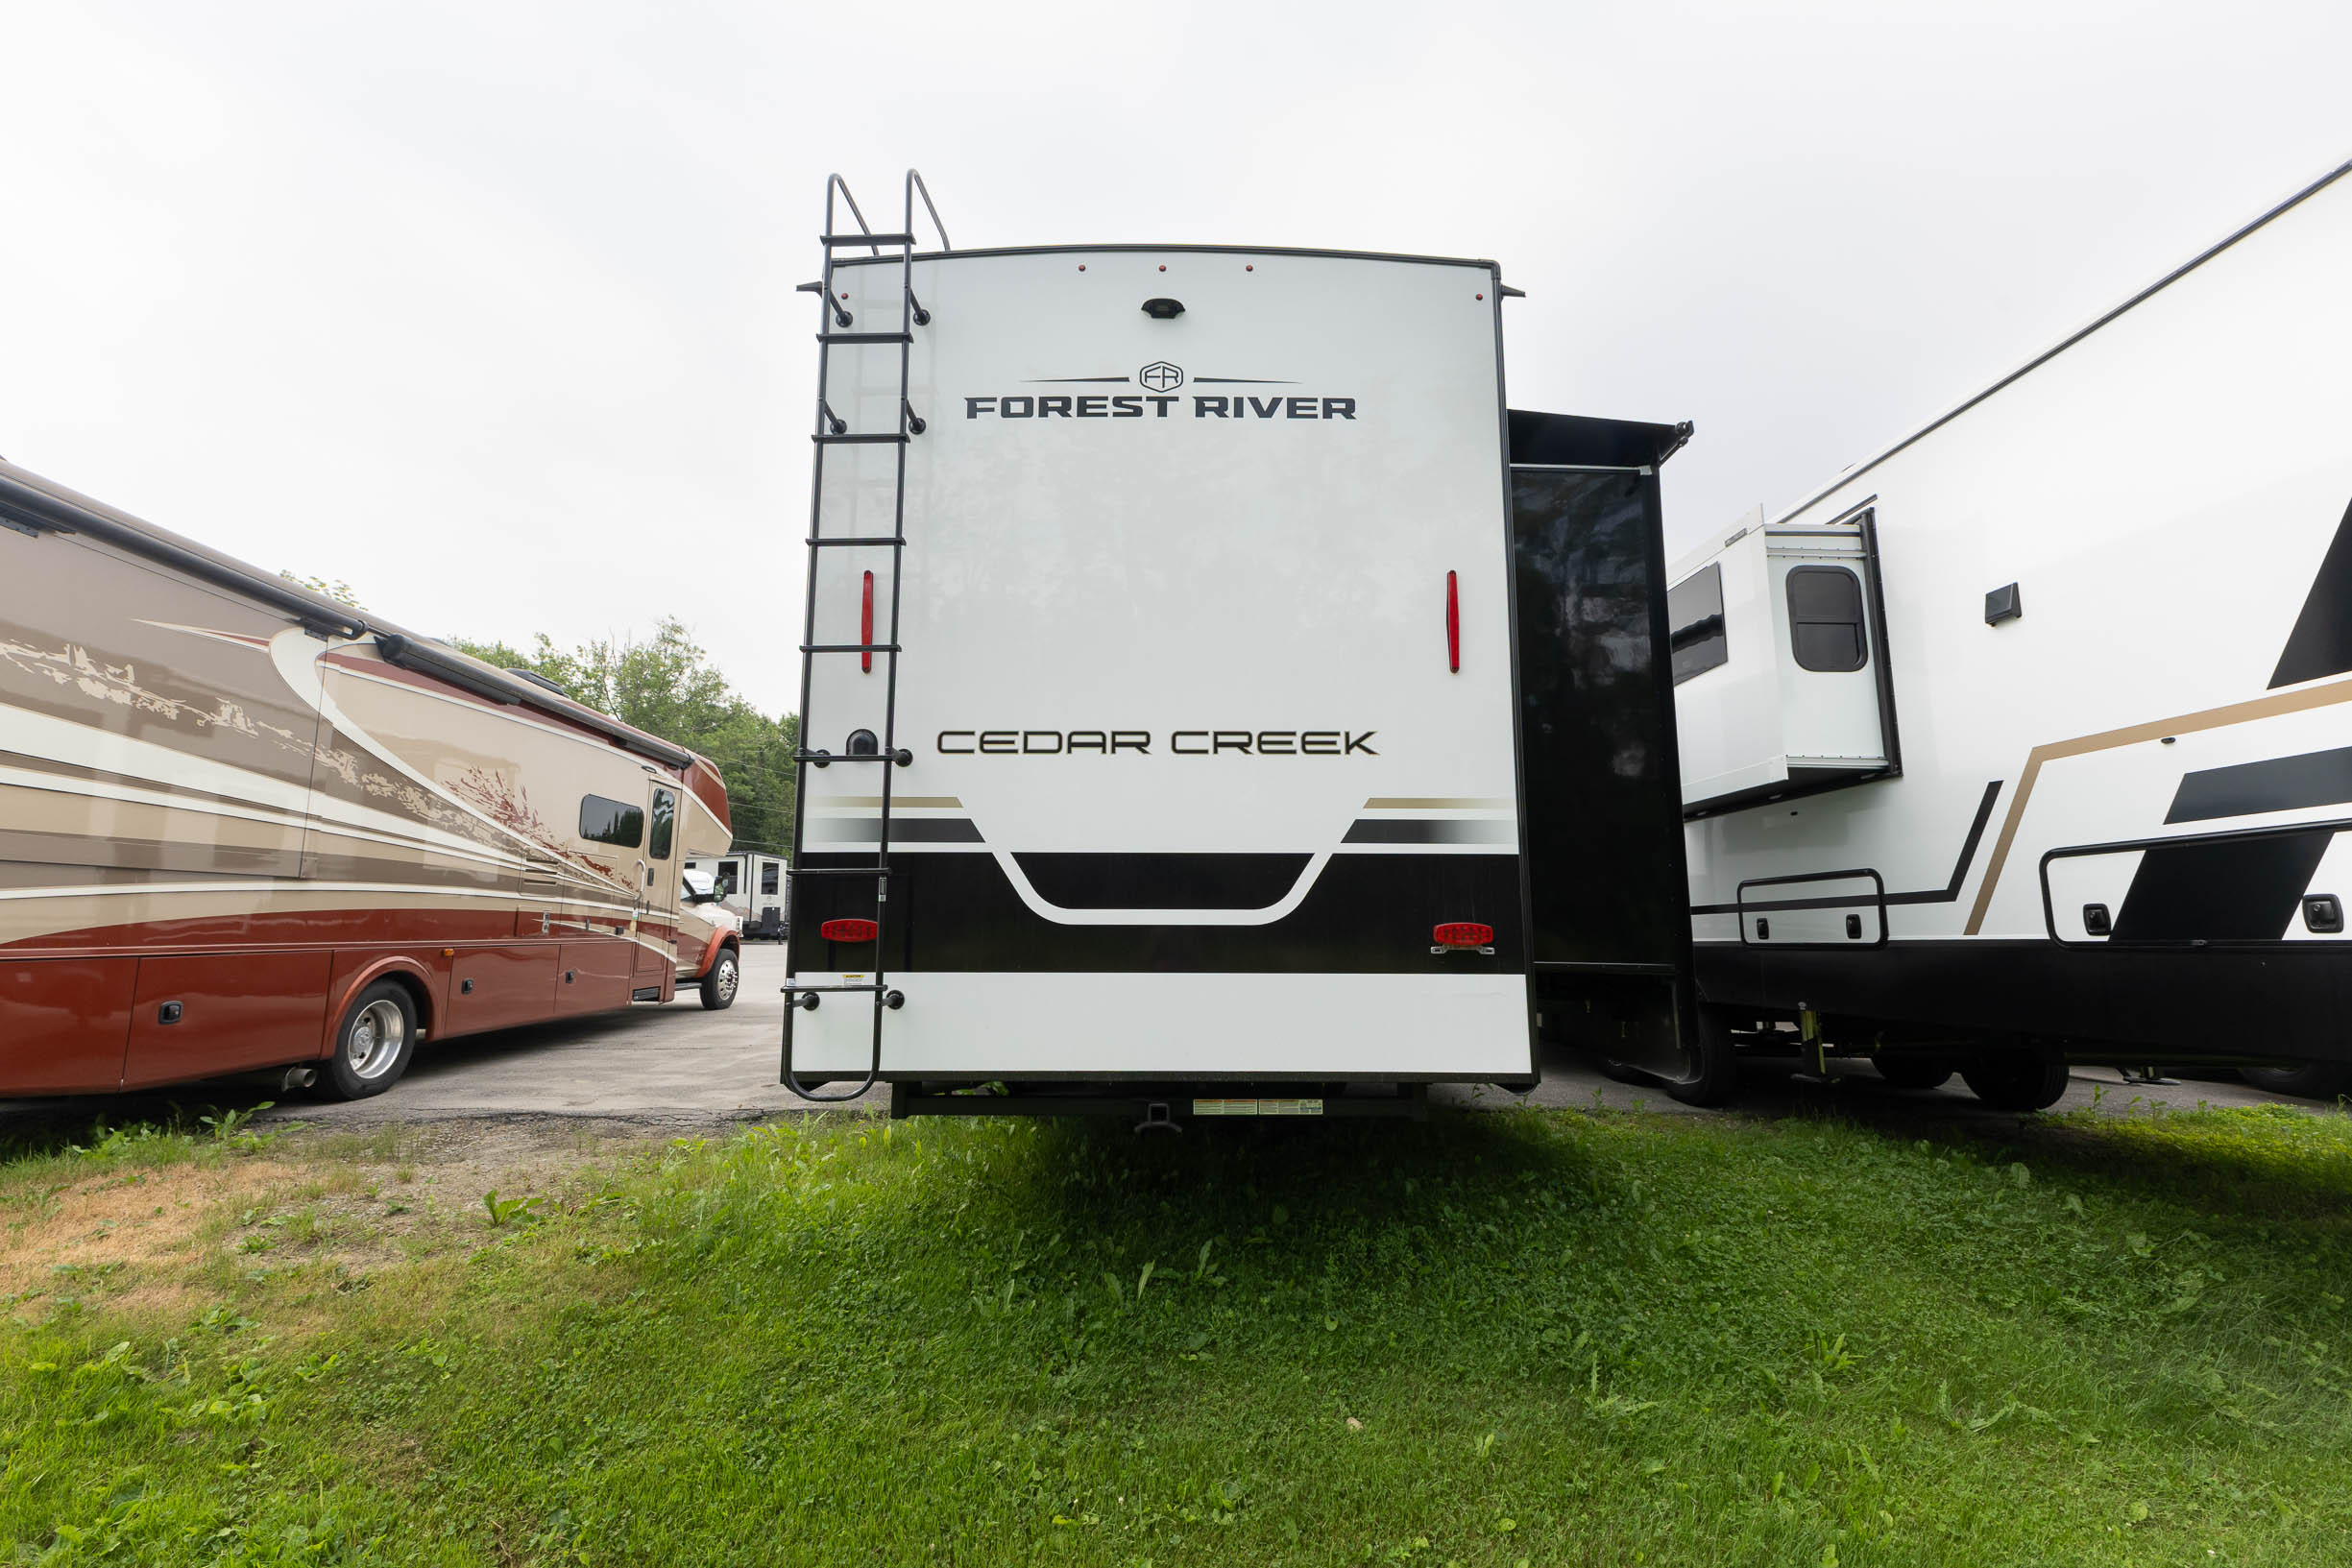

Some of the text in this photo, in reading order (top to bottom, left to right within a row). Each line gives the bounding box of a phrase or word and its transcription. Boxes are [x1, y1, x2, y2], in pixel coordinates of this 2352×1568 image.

[1145, 366, 1178, 388] FR
[964, 396, 1357, 420] FOREST RIVER
[936, 731, 1380, 756] CEDAR CREEK
